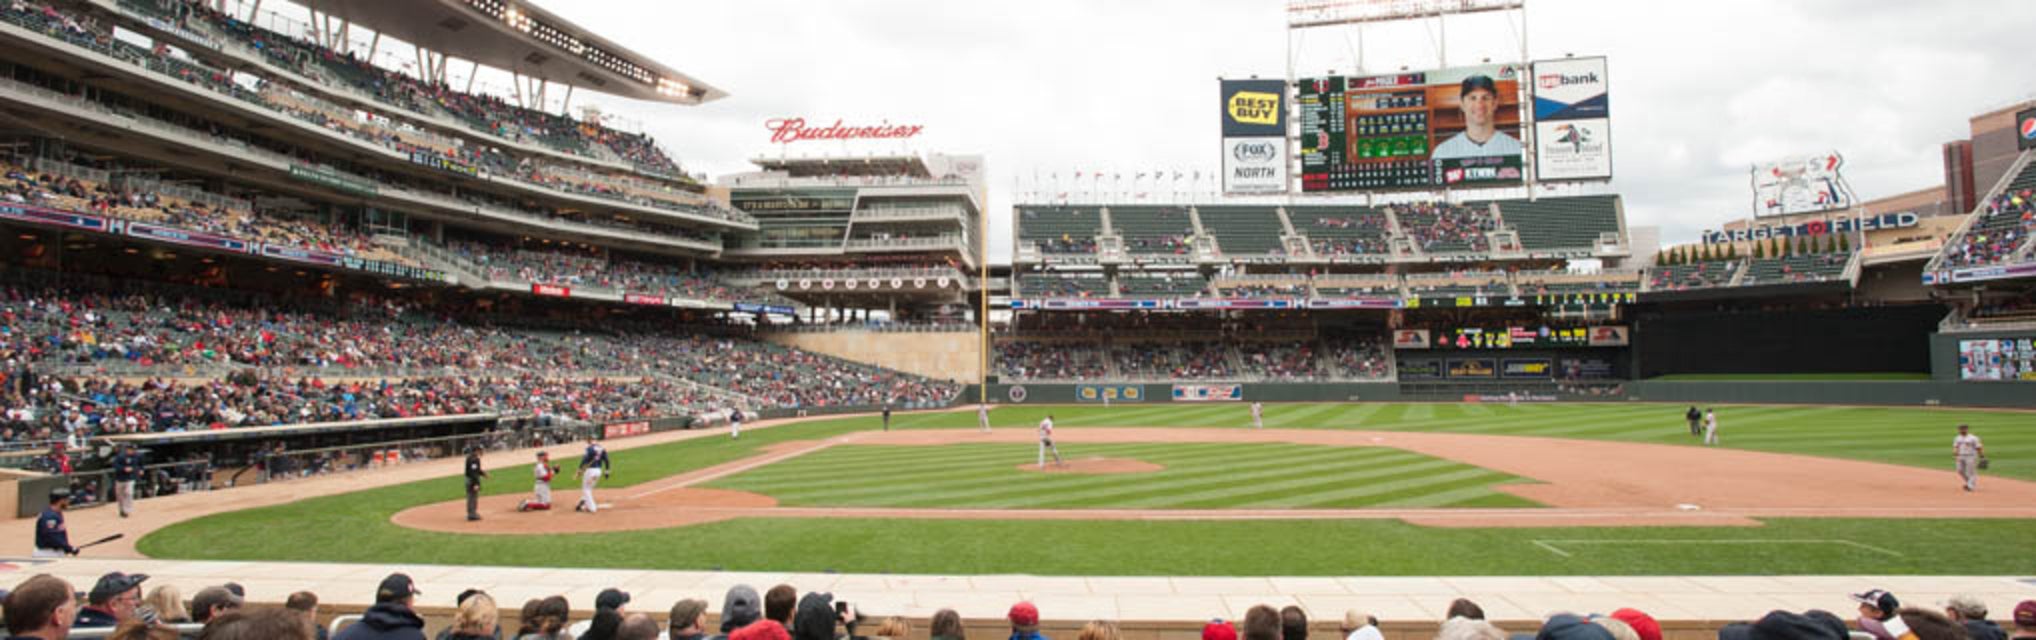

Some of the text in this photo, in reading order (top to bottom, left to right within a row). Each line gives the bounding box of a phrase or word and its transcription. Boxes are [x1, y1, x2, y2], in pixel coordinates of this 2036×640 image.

[1235, 98, 1277, 109] BEST
[1235, 107, 1273, 119] BUY
[765, 117, 925, 144] Budweiser
[1241, 143, 1267, 155] FOX
[1233, 166, 1276, 178] NORTH
[1702, 212, 1919, 244] TARGET FIELD
